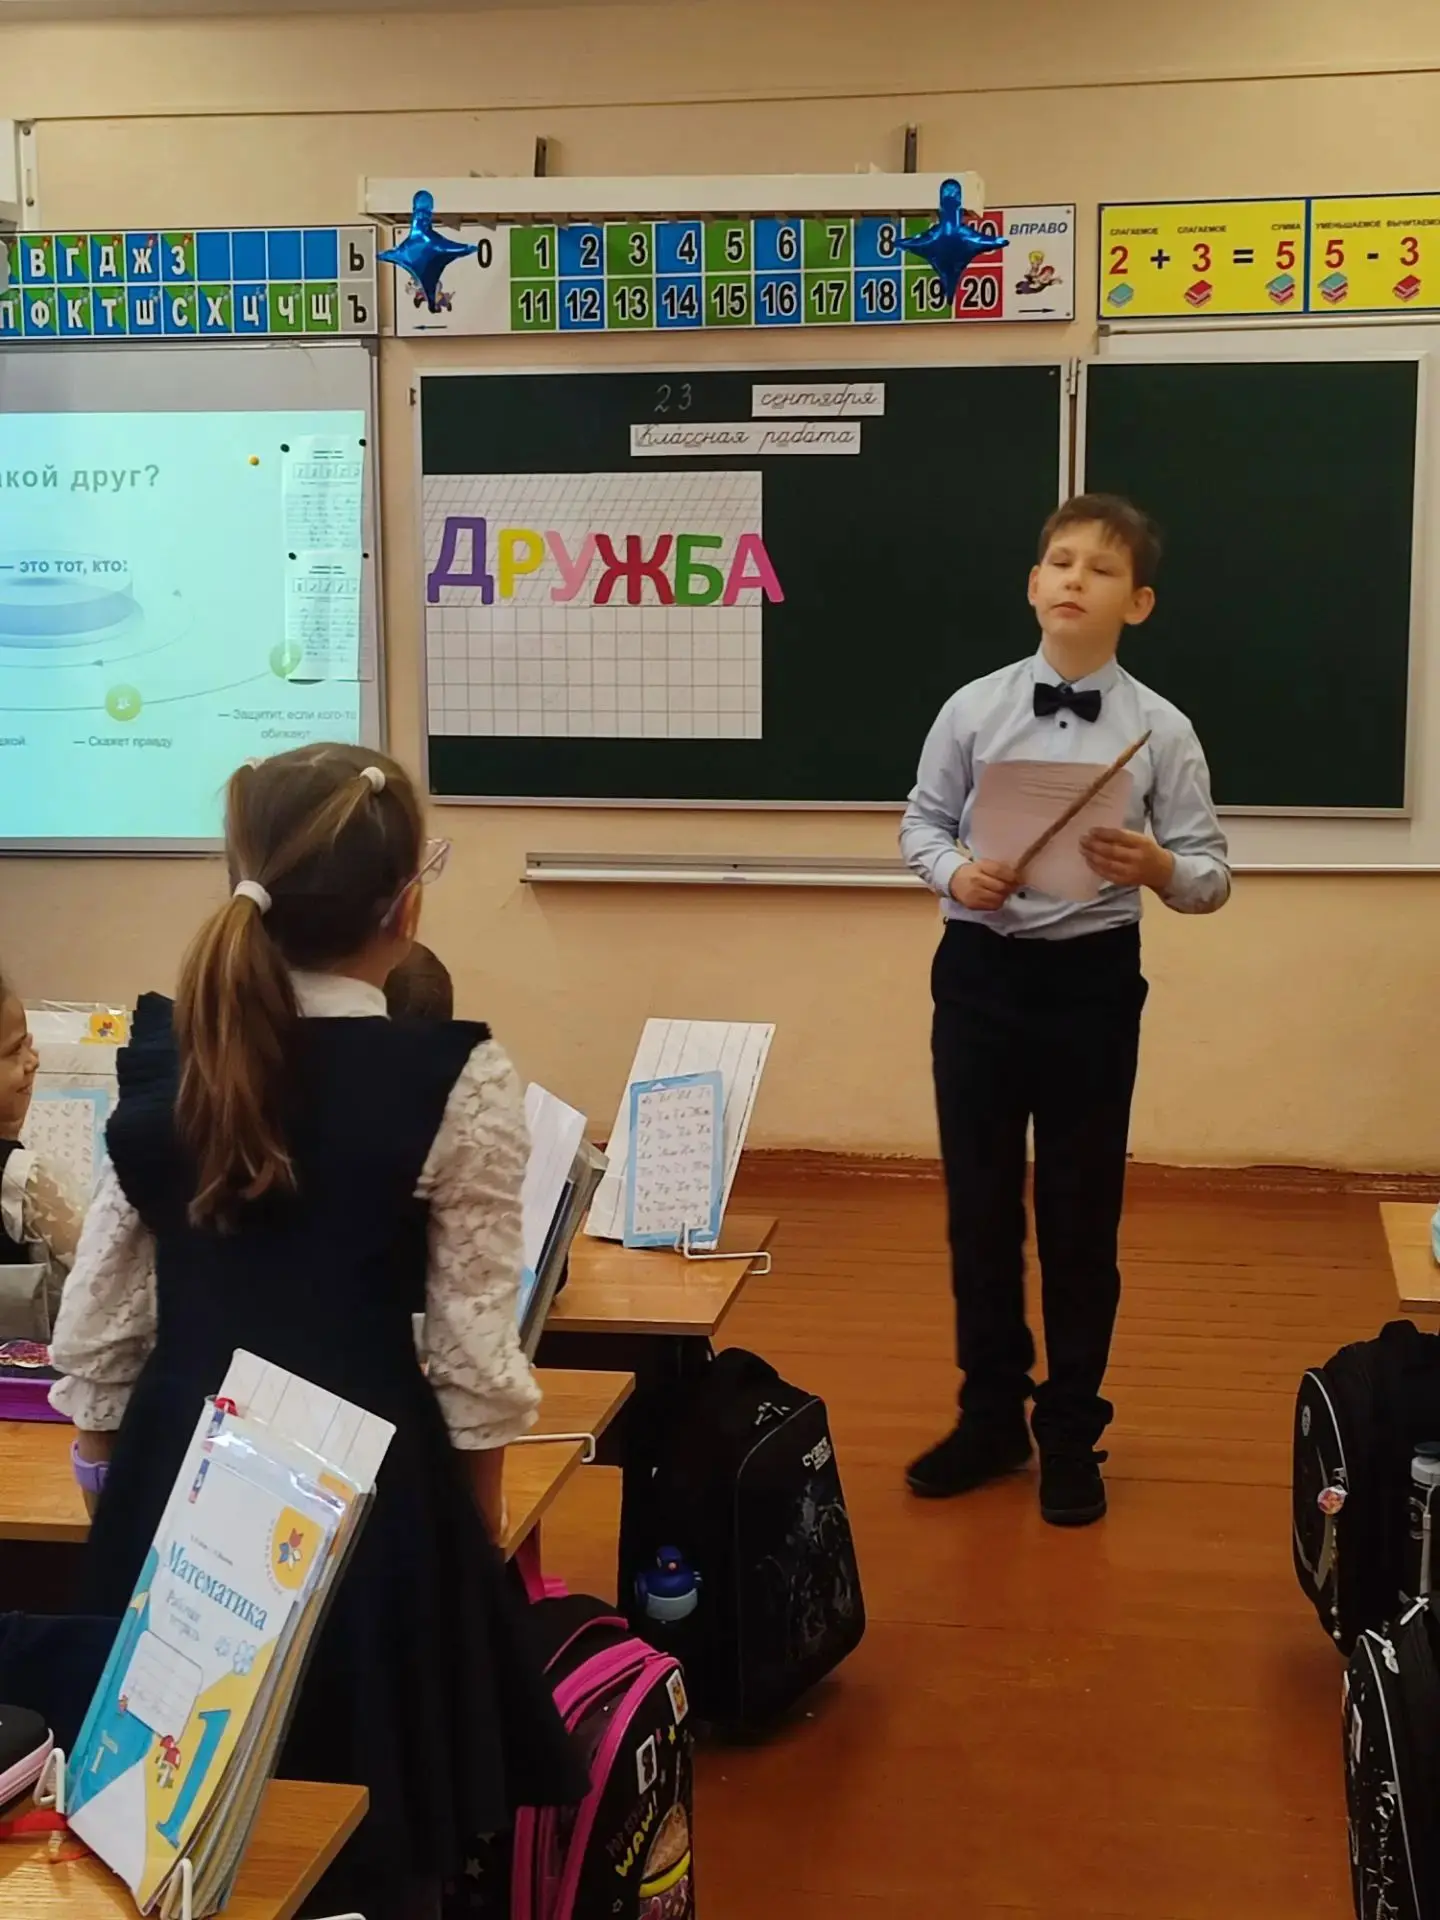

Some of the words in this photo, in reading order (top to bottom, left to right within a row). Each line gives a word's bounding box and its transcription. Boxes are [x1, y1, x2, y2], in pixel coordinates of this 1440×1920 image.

[1009, 222, 1068, 235] ВПРАВО
[30, 248, 46, 277] В
[65, 247, 80, 277] Г
[100, 246, 117, 277] Д
[132, 247, 153, 274] Ж
[171, 245, 186, 276] З
[349, 242, 365, 272] Ь
[477, 238, 492, 269] 0
[533, 235, 549, 270] 1
[580, 233, 600, 268] 2
[628, 231, 648, 267] 3
[676, 230, 698, 265] 4
[725, 229, 745, 263] 5
[777, 227, 797, 262] 6
[827, 226, 847, 260] 7
[877, 224, 896, 258] 8
[1109, 245, 1129, 275] 2
[1192, 243, 1212, 272] 3
[1275, 240, 1296, 270] 5
[1325, 239, 1345, 269] 5
[1399, 236, 1420, 267] 3
[30, 300, 50, 328] Ф
[67, 299, 83, 329] К
[101, 298, 117, 328] Т
[135, 300, 154, 325] Ш
[172, 297, 188, 327] С
[206, 300, 224, 326] Х
[243, 295, 260, 326] Ц
[277, 295, 295, 325] Ч
[311, 293, 331, 324] Щ
[348, 295, 367, 324] Ъ
[519, 289, 551, 323] 11
[565, 287, 600, 322] 12
[613, 286, 649, 321] 13
[662, 285, 698, 320] 14
[712, 284, 747, 318] 15
[761, 281, 797, 316] 16
[811, 279, 846, 315] 17
[861, 278, 897, 314] 18
[911, 276, 947, 312] 19
[960, 275, 997, 311] 20
[760, 383, 877, 416] сентября
[757, 422, 855, 454] работа
[0, 464, 58, 489] кой
[70, 463, 160, 493] друг?
[19, 560, 50, 573] это
[427, 516, 785, 607] ДРУЖБА
[164, 1540, 269, 1632] Математика
[155, 1708, 231, 1850] 1
